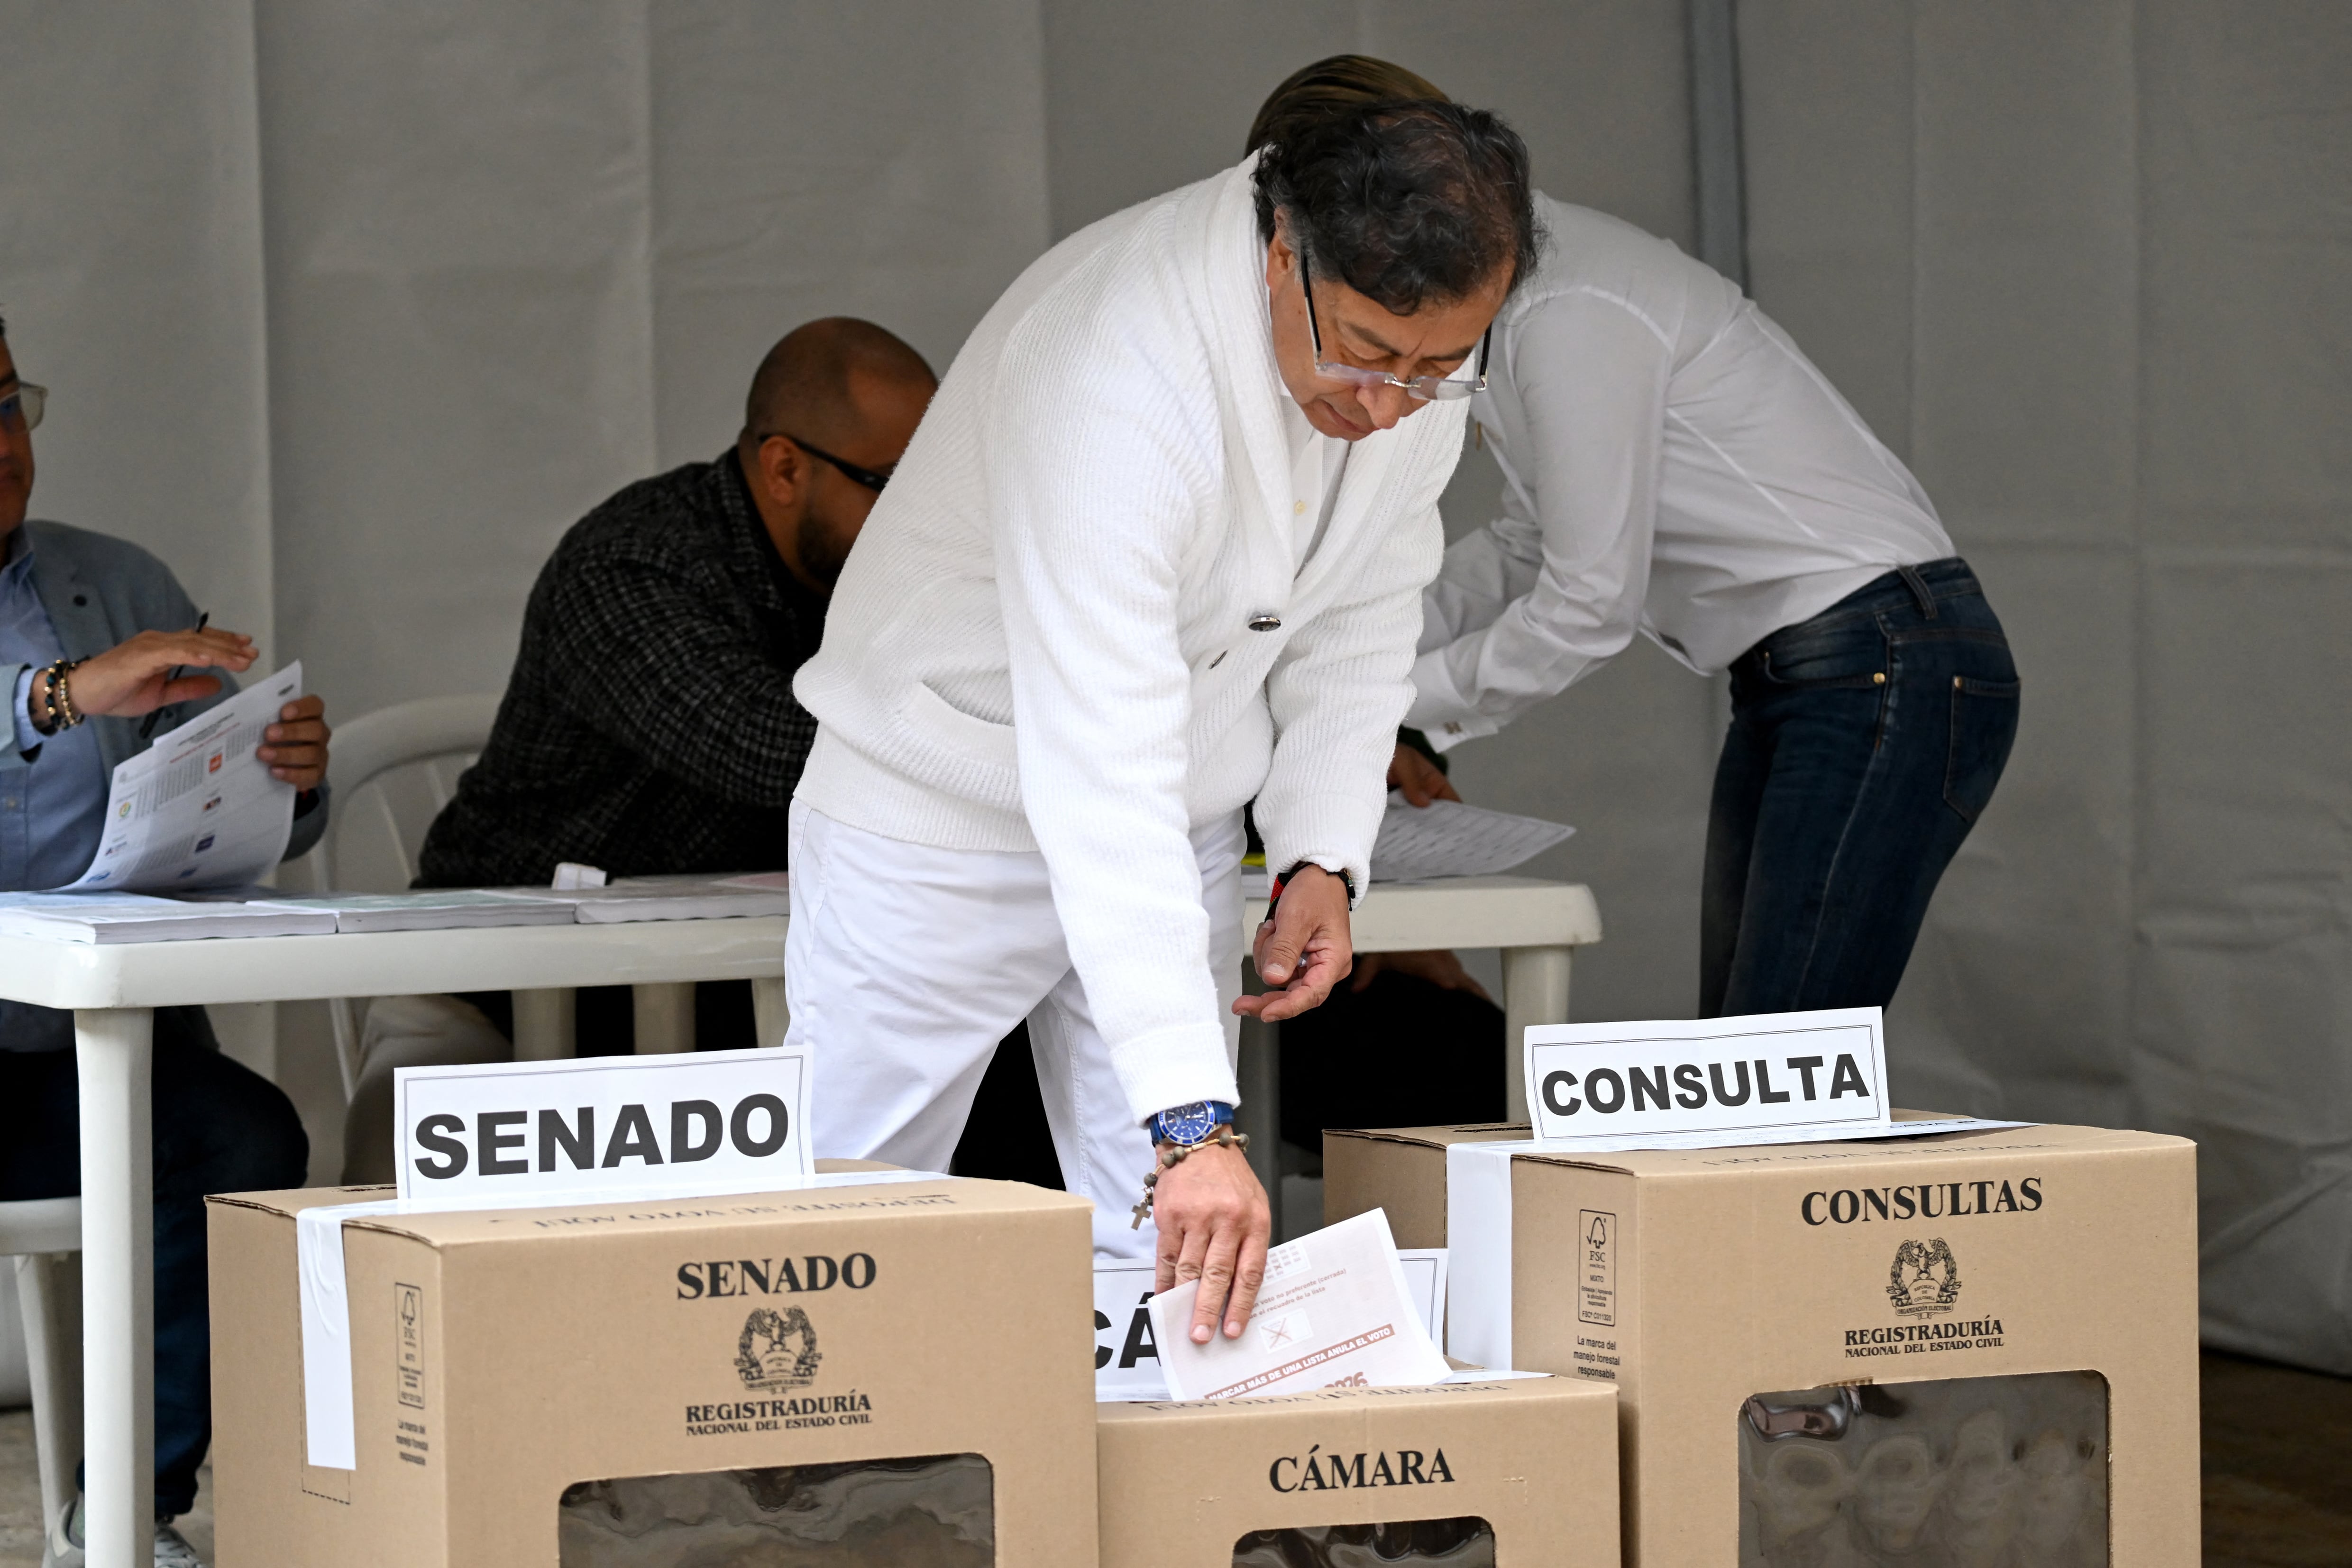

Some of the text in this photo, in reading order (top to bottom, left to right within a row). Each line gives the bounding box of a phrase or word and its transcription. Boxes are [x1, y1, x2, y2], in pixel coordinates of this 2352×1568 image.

[1542, 1054, 1870, 1116] CONSULTA
[415, 1093, 788, 1179] SENADO
[1802, 1177, 2042, 1226] CONSULTAS
[1589, 1251, 1606, 1262] FSC
[677, 1252, 876, 1300] SENADO
[1260, 1296, 1275, 1304] voto
[1285, 1280, 1317, 1297] preferente
[1318, 1268, 1346, 1284] (cerrada)
[1590, 1275, 1604, 1283] MIXTO
[1267, 1299, 1294, 1312] recuadro
[1577, 1335, 1616, 1351] La marca del
[1845, 1315, 2004, 1346] REGISTRADURÍA
[1246, 1376, 1267, 1389] MÁS
[1268, 1370, 1282, 1381] DE
[1282, 1362, 1302, 1375] UNA
[1302, 1353, 1327, 1367] LISTA
[1327, 1342, 1356, 1358] ANULA
[1356, 1338, 1368, 1347] EL
[1367, 1328, 1391, 1341] VOTO
[1574, 1351, 1620, 1366] manejo forestal
[1845, 1337, 2004, 1357] NACIONAL DEL ESTADO CIVIL
[1578, 1366, 1615, 1379] responsable
[686, 1388, 872, 1422] REGISTRADURÍA
[686, 1413, 872, 1436] NACIONAL DEL ESTADO CIVIL
[1269, 1444, 1455, 1493] CÁMARA
